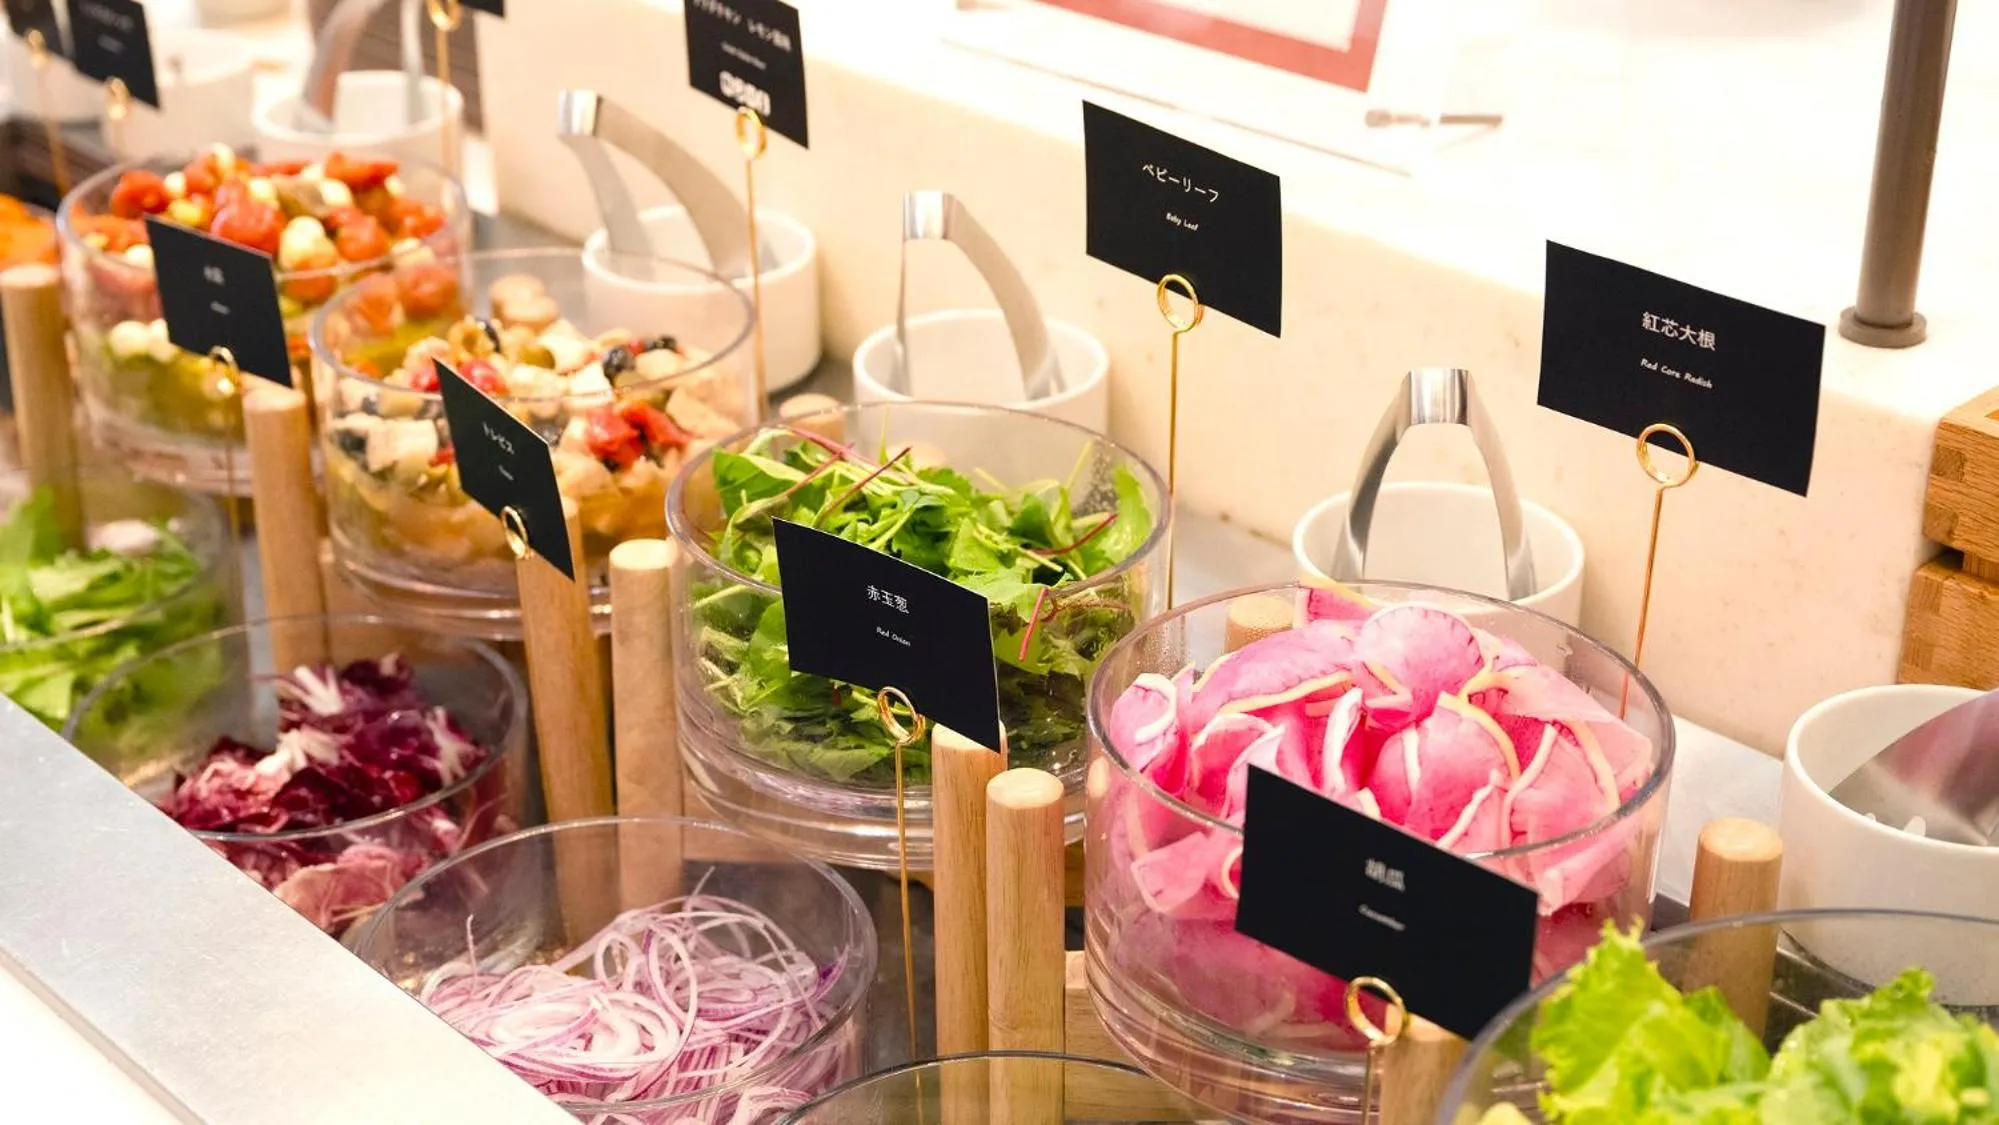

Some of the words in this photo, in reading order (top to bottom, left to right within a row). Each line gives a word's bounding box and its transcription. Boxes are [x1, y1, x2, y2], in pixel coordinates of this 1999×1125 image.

[1142, 164, 1218, 202] ベビーリーフ
[1166, 213, 1181, 226] Baby
[1183, 219, 1198, 231] Leaf
[1642, 312, 1715, 351] 紅芯大根
[1641, 358, 1658, 370] Red
[1661, 366, 1680, 378] Core
[1684, 373, 1712, 388] Radish
[867, 585, 909, 613] 赤玉葱
[877, 627, 889, 637] Red
[892, 634, 910, 646] Onion
